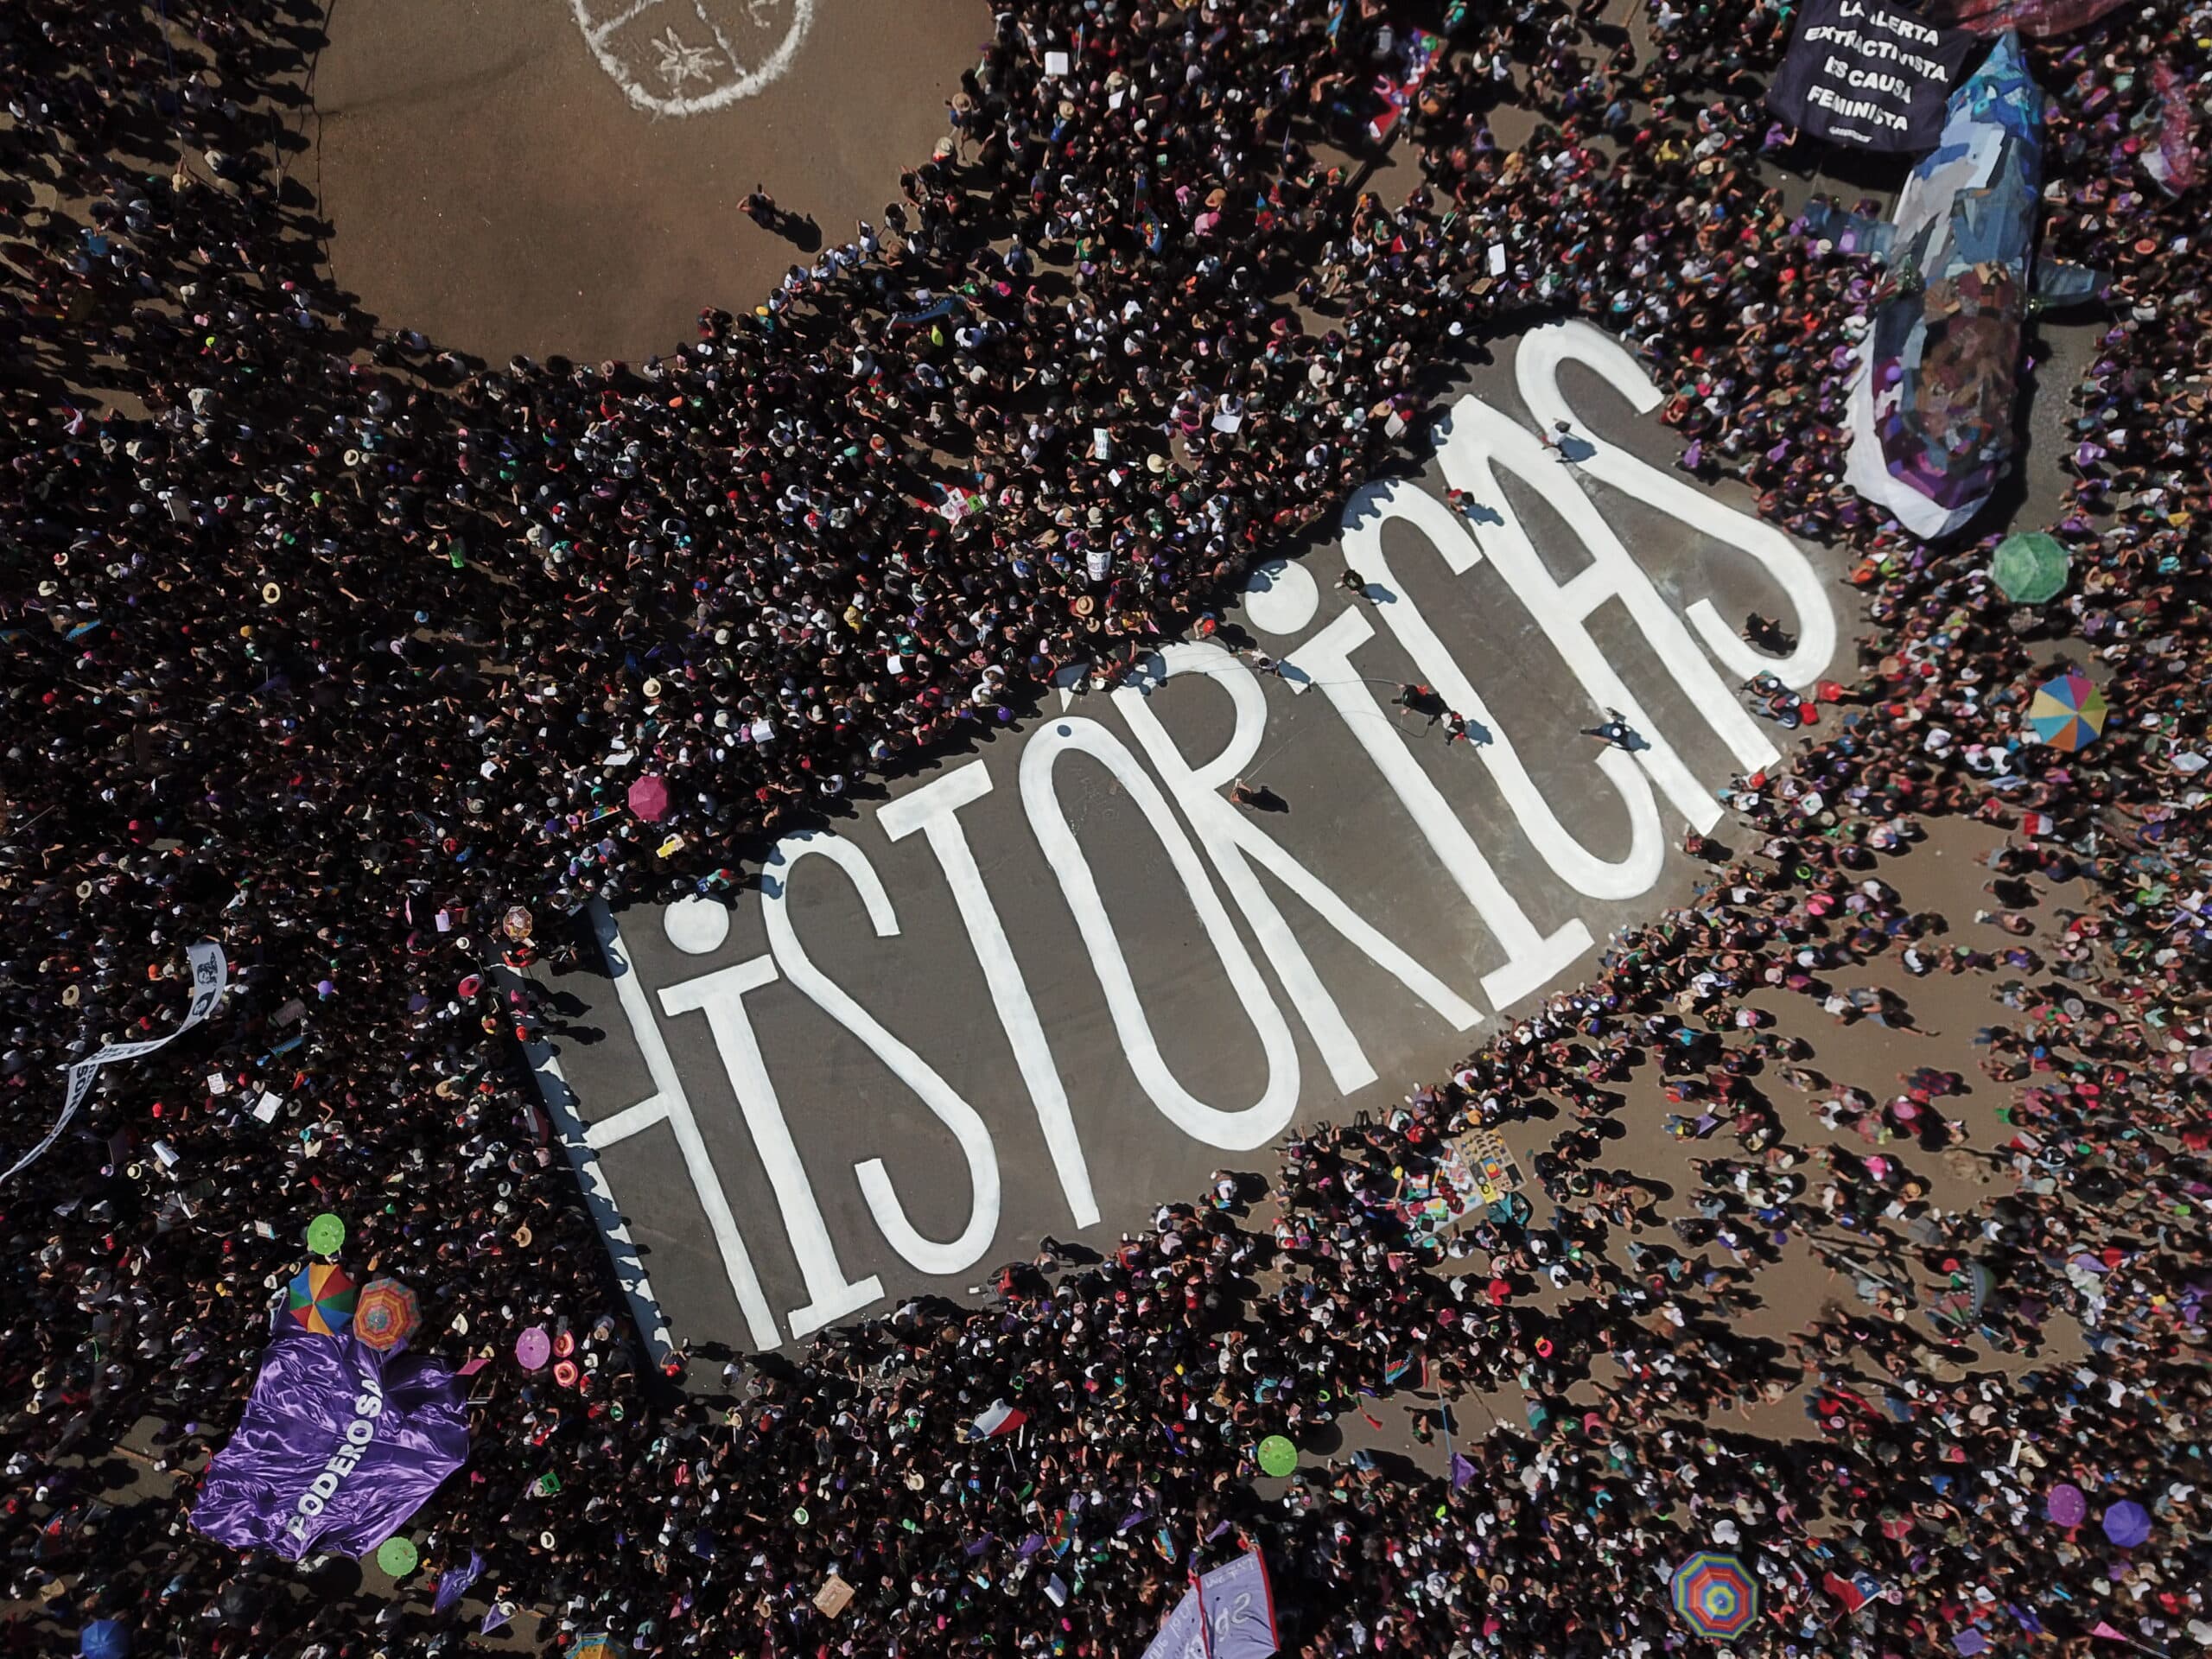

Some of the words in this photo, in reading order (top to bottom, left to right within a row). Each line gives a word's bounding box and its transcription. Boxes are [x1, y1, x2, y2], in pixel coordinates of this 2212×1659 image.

[1840, 0, 1866, 17] LA
[1807, 85, 1909, 131] FEMINISTA
[284, 1369, 383, 1541] PODEROSA
